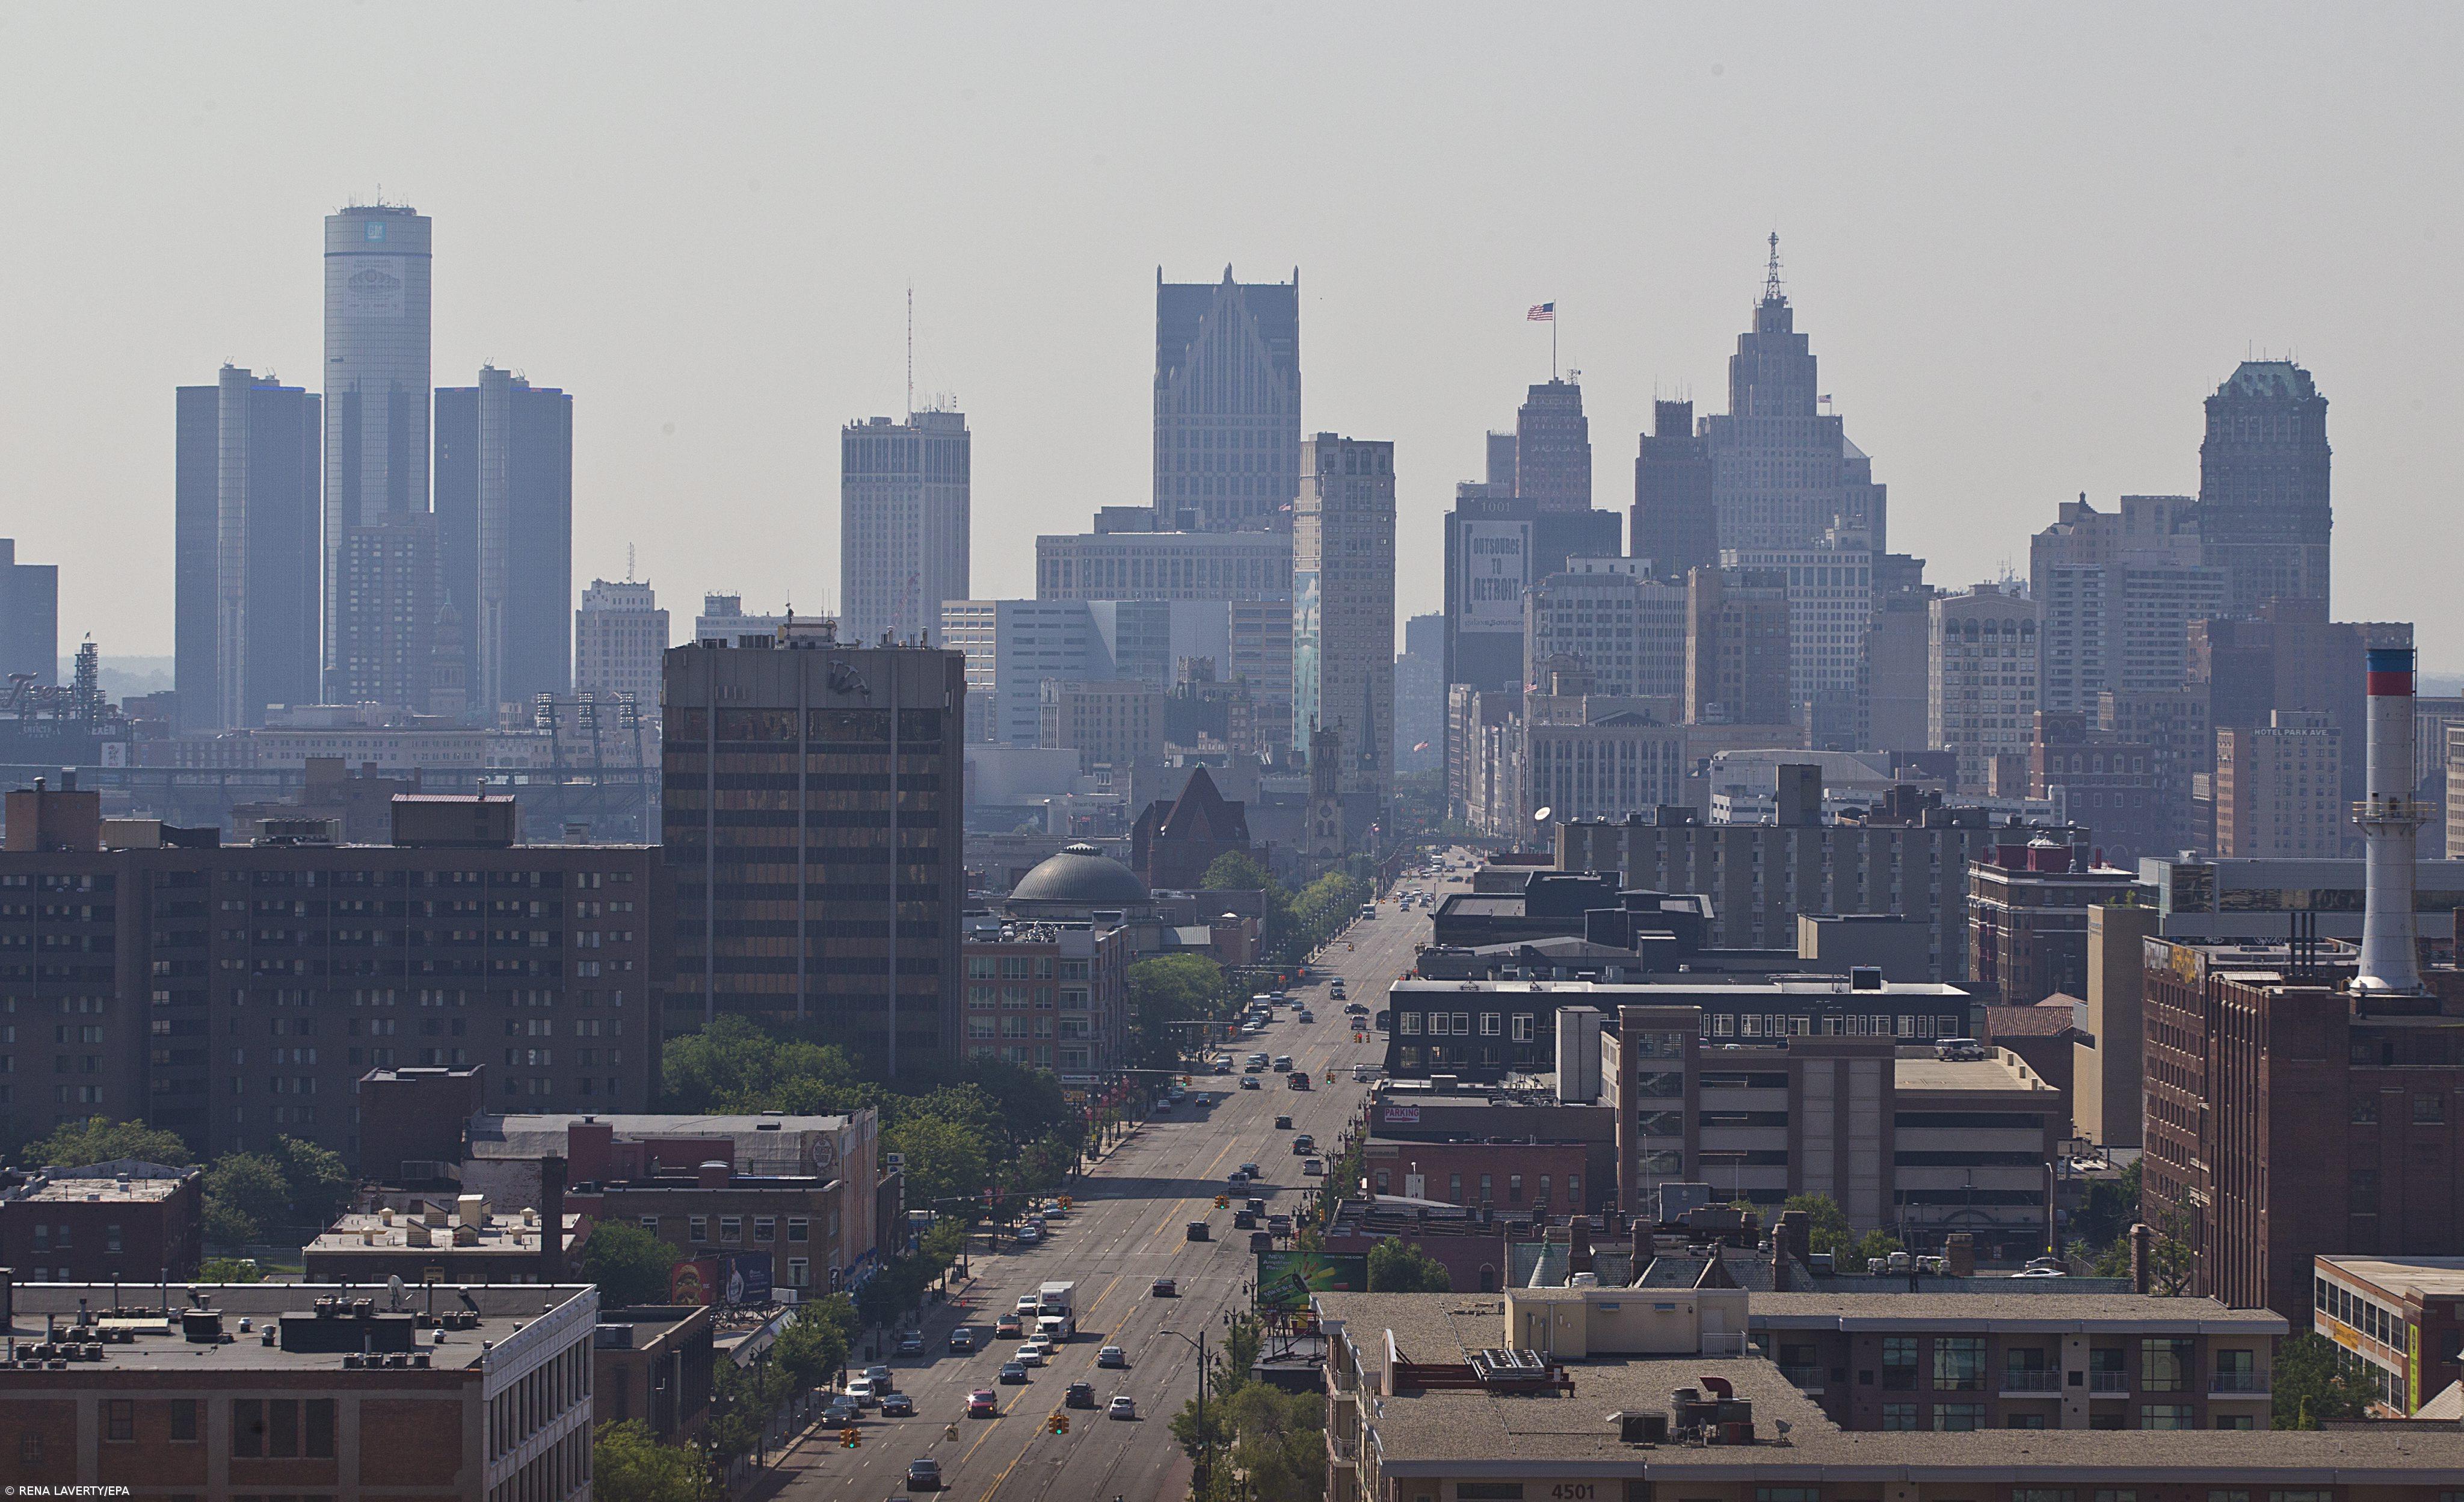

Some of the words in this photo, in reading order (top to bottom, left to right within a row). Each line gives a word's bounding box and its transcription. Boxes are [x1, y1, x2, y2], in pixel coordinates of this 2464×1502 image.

[368, 225, 383, 236] GM
[1482, 502, 1511, 511] 1001
[1474, 537, 1520, 555] OUTSOURCE
[1492, 558, 1502, 575] TO
[1474, 578, 1519, 601] DETROIT
[1385, 1108, 1419, 1117] PARKING
[1264, 1287, 1281, 1297] Mike
[1551, 1484, 1594, 1500] 4501
